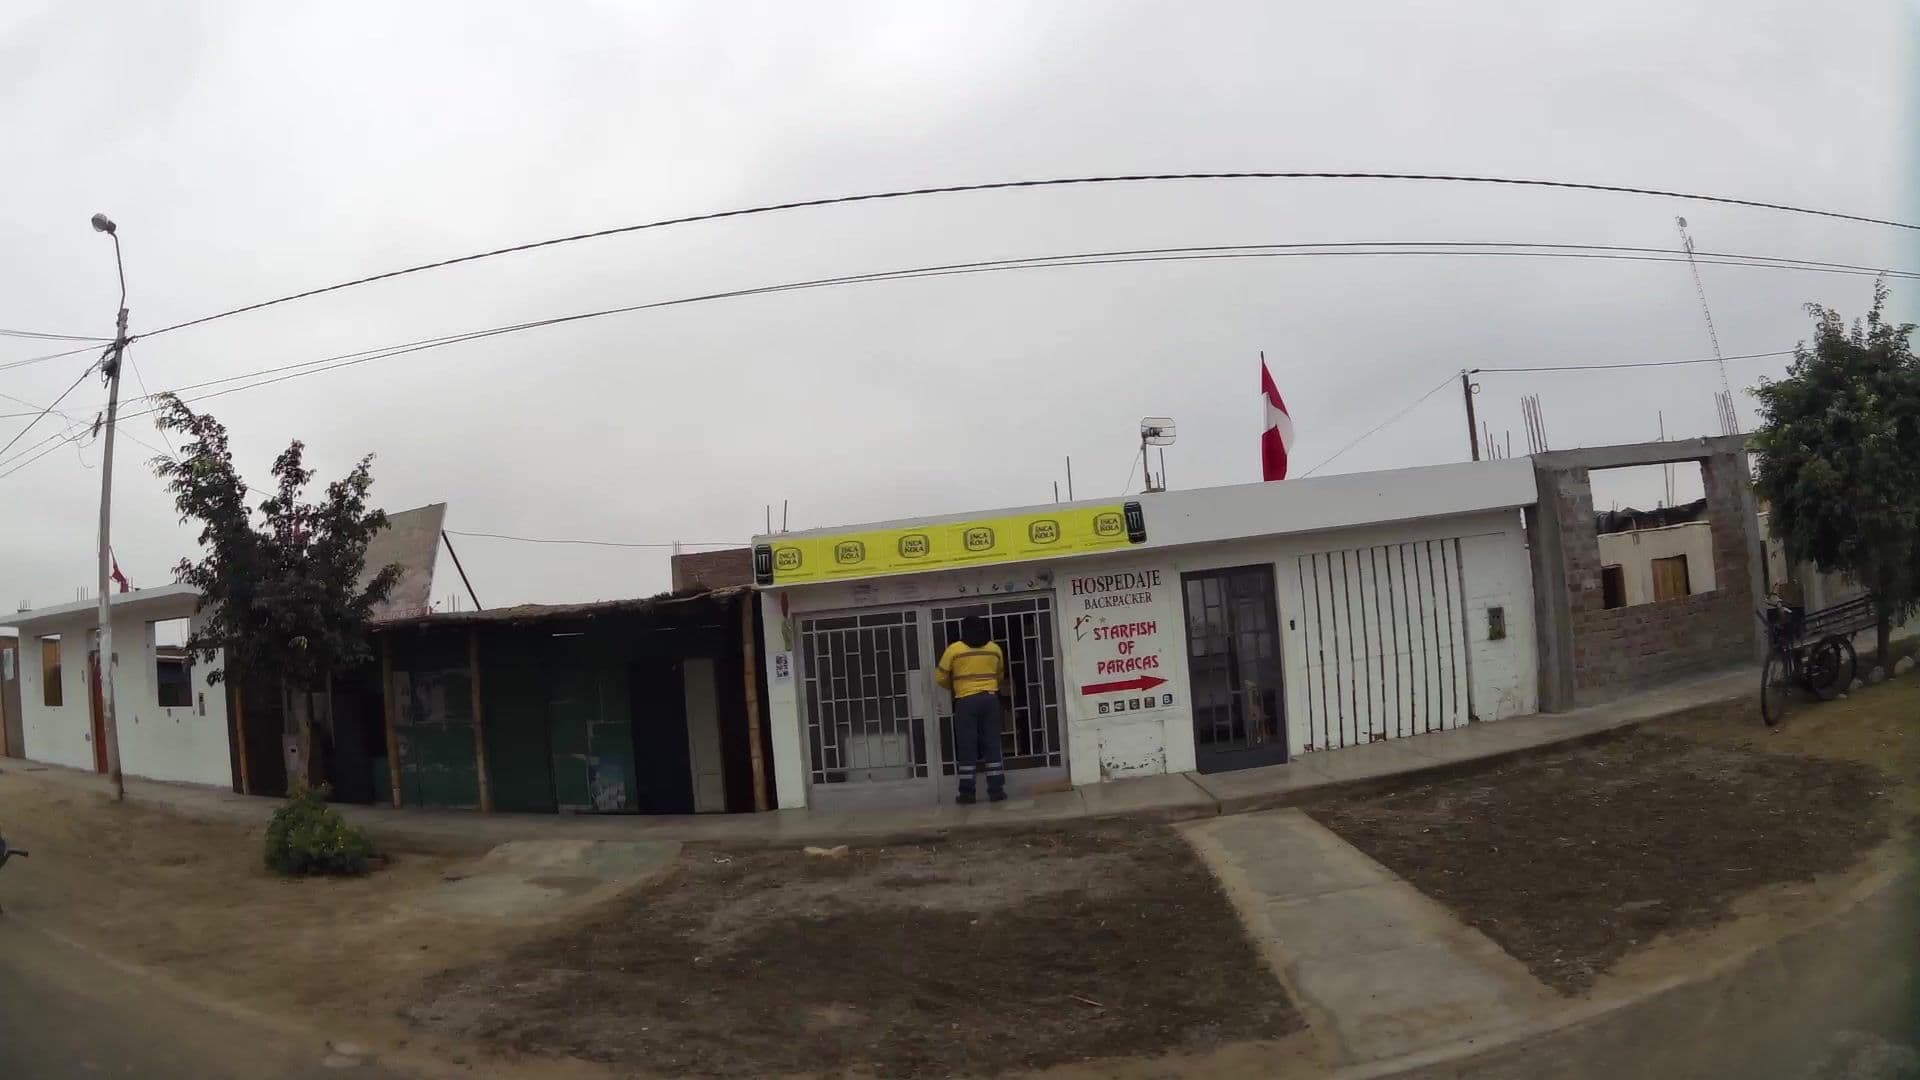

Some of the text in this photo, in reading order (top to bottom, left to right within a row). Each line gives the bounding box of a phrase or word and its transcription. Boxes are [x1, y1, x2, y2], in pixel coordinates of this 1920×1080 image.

[1100, 524, 1119, 532] KOLA
[970, 532, 987, 540] INCA
[1035, 531, 1054, 539] KOLA
[904, 539, 922, 547] INCA
[970, 538, 989, 546] KOLA
[841, 546, 858, 554] INCA
[904, 545, 924, 554] KOLA
[779, 552, 796, 560] INCA
[841, 552, 860, 561] KOLA
[779, 558, 798, 566] KOLA
[1072, 570, 1161, 595] HOSPEDAJE
[1084, 592, 1153, 610] BACKPACKER
[1093, 621, 1157, 640] STARFISH
[1118, 641, 1135, 655] OF
[1097, 655, 1160, 674] PARACAS
